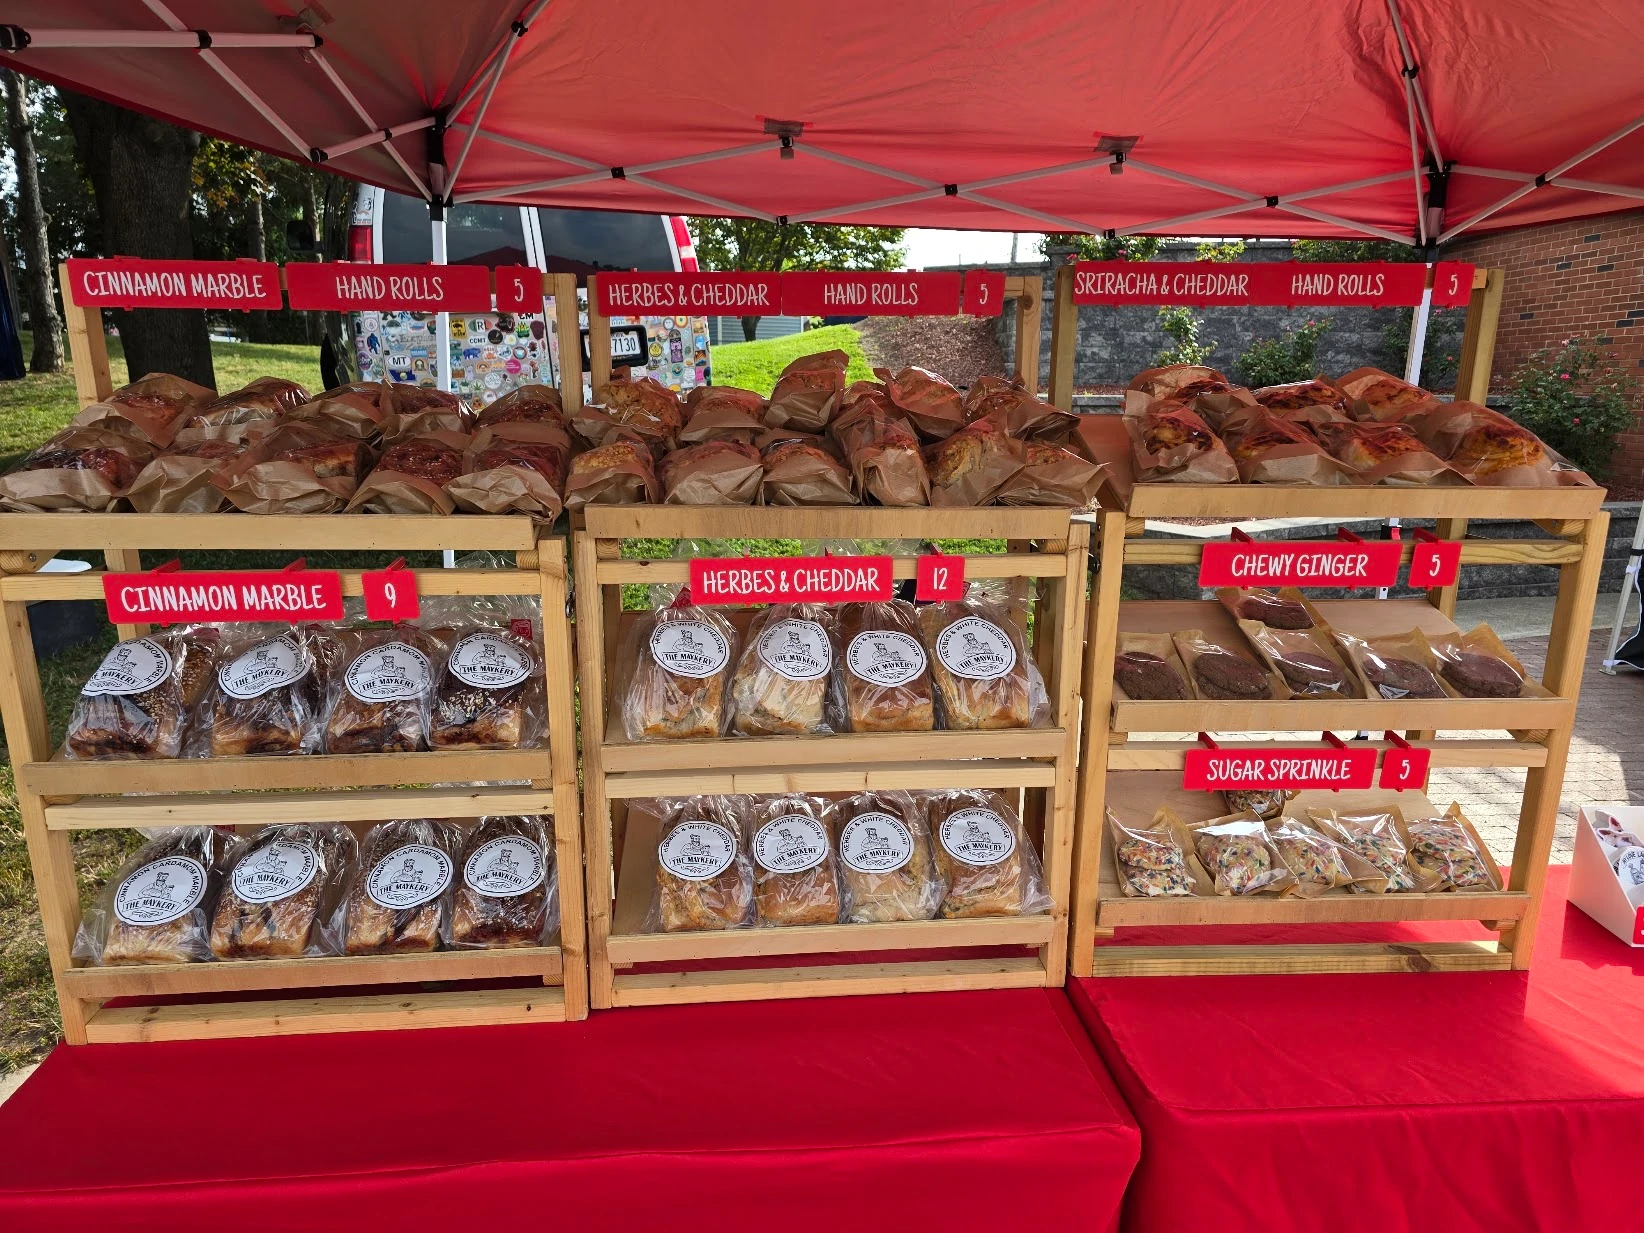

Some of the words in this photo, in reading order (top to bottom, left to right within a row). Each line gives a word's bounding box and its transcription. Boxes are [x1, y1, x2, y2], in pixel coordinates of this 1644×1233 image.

[84, 271, 187, 297] CINNAMON
[190, 272, 267, 299] MARBLE
[336, 275, 386, 300] HAND
[389, 276, 444, 301] ROLLS
[513, 278, 524, 302] 5
[609, 282, 675, 307] HERBES
[678, 284, 688, 306] &
[690, 283, 770, 306] CHEDDAR
[824, 282, 867, 305] HAND
[871, 282, 919, 306] ROLLS
[979, 283, 989, 305] 5
[1074, 271, 1158, 296] SRIRACHA
[1160, 273, 1170, 296] &
[1173, 273, 1250, 297] CHEDDAR
[1291, 273, 1334, 296] HAND
[1337, 273, 1385, 296] ROLLS
[1448, 274, 1458, 296] 5
[392, 356, 407, 365] MT
[1231, 553, 1295, 577] CHEWY
[1296, 553, 1369, 577] GINGER
[1429, 554, 1441, 577] 5
[703, 569, 776, 595] HERBES
[779, 570, 790, 594] &
[793, 567, 881, 593] CHEDDAR
[933, 567, 948, 591] 12
[120, 584, 238, 613] CINNAMON
[242, 583, 327, 611] MARBLE
[384, 582, 397, 609] 9
[955, 621, 980, 630] WHITE
[680, 653, 713, 665] MAYKERY
[867, 666, 880, 674] THE
[882, 662, 914, 670] MAYKERY
[959, 660, 973, 669] THE
[101, 671, 136, 685] MAYKERY
[480, 666, 515, 676] MAYKERY
[234, 677, 249, 688] THE
[362, 681, 375, 691] THE
[379, 678, 415, 688] MAYKERY
[1206, 758, 1265, 781] SUGAR
[1266, 758, 1352, 781] SPRINKLE
[1399, 759, 1411, 781] 5
[773, 818, 795, 827] WHITE
[672, 857, 684, 865] THE
[687, 857, 718, 865] MAYKERY
[773, 856, 786, 865] THE
[787, 847, 818, 858] MAYKERY
[856, 853, 868, 862] THE
[152, 860, 196, 876] CARDAMOM
[183, 876, 199, 905] MARBLE
[242, 876, 254, 885] THE
[257, 874, 291, 886] MAYKERY
[380, 886, 392, 895] THE
[396, 883, 430, 892] MAYKERY
[492, 872, 523, 884] MAYKERY
[125, 901, 139, 909] THE
[142, 899, 177, 911] MAYKERY
